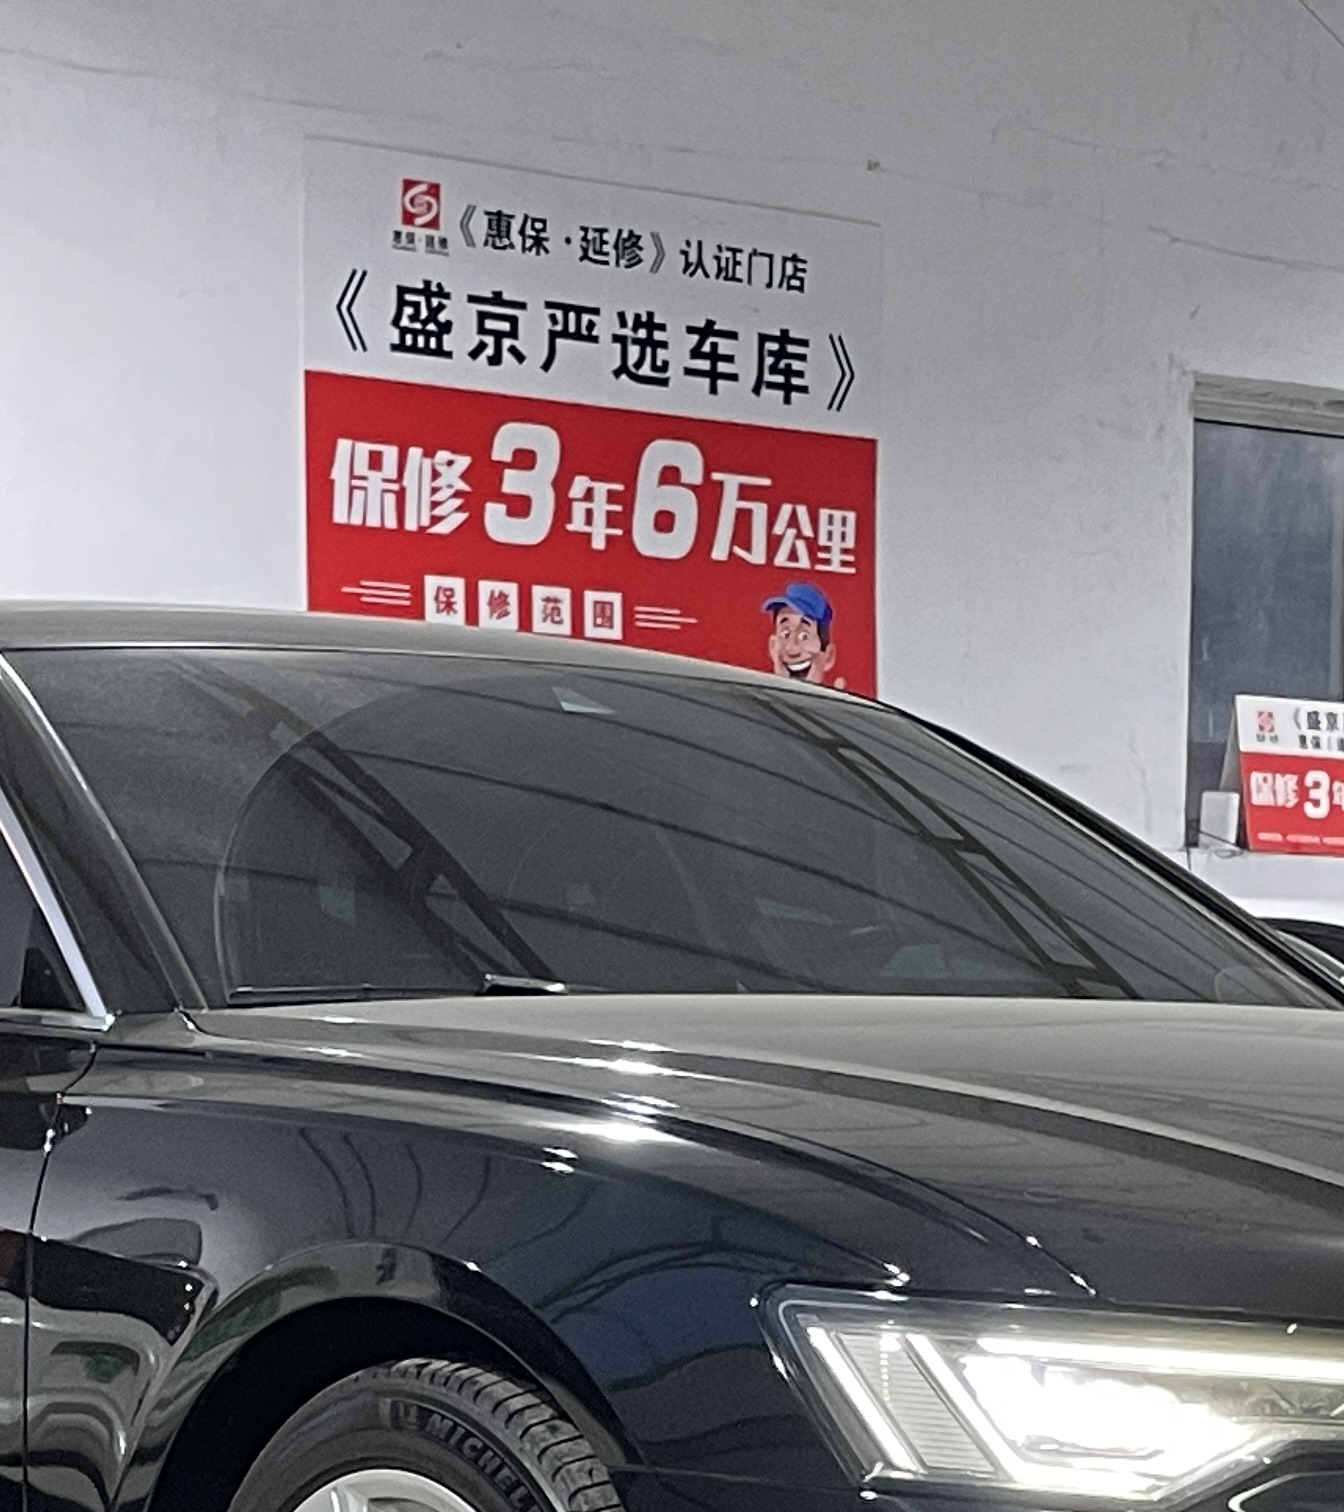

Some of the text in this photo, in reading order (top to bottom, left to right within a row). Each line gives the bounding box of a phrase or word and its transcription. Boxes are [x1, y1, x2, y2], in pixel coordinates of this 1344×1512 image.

[336, 268, 856, 412] 《盛京严选车库》
[330, 421, 857, 575] 保修3年6万公里
